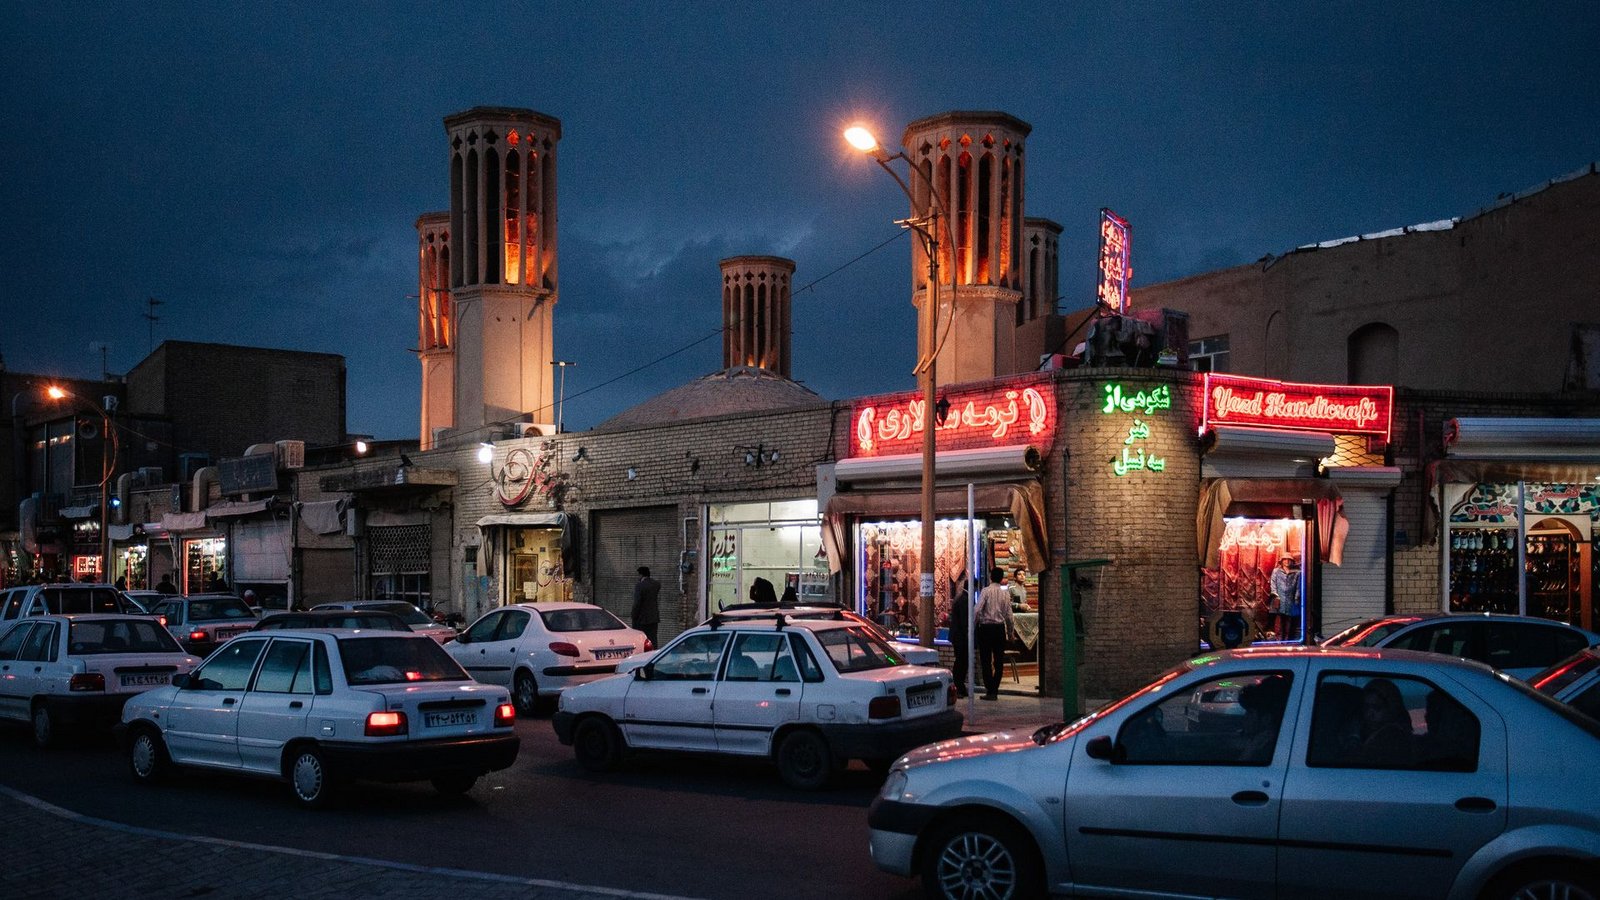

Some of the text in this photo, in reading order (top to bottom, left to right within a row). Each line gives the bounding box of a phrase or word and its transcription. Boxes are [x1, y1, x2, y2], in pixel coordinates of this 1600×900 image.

[1102, 384, 1121, 414] از
[1212, 386, 1378, 427] Yazd Handicraft
[878, 390, 1019, 440] ترمه سلاری
[1124, 418, 1150, 445] هنر
[1114, 447, 1165, 476] سه نسل
